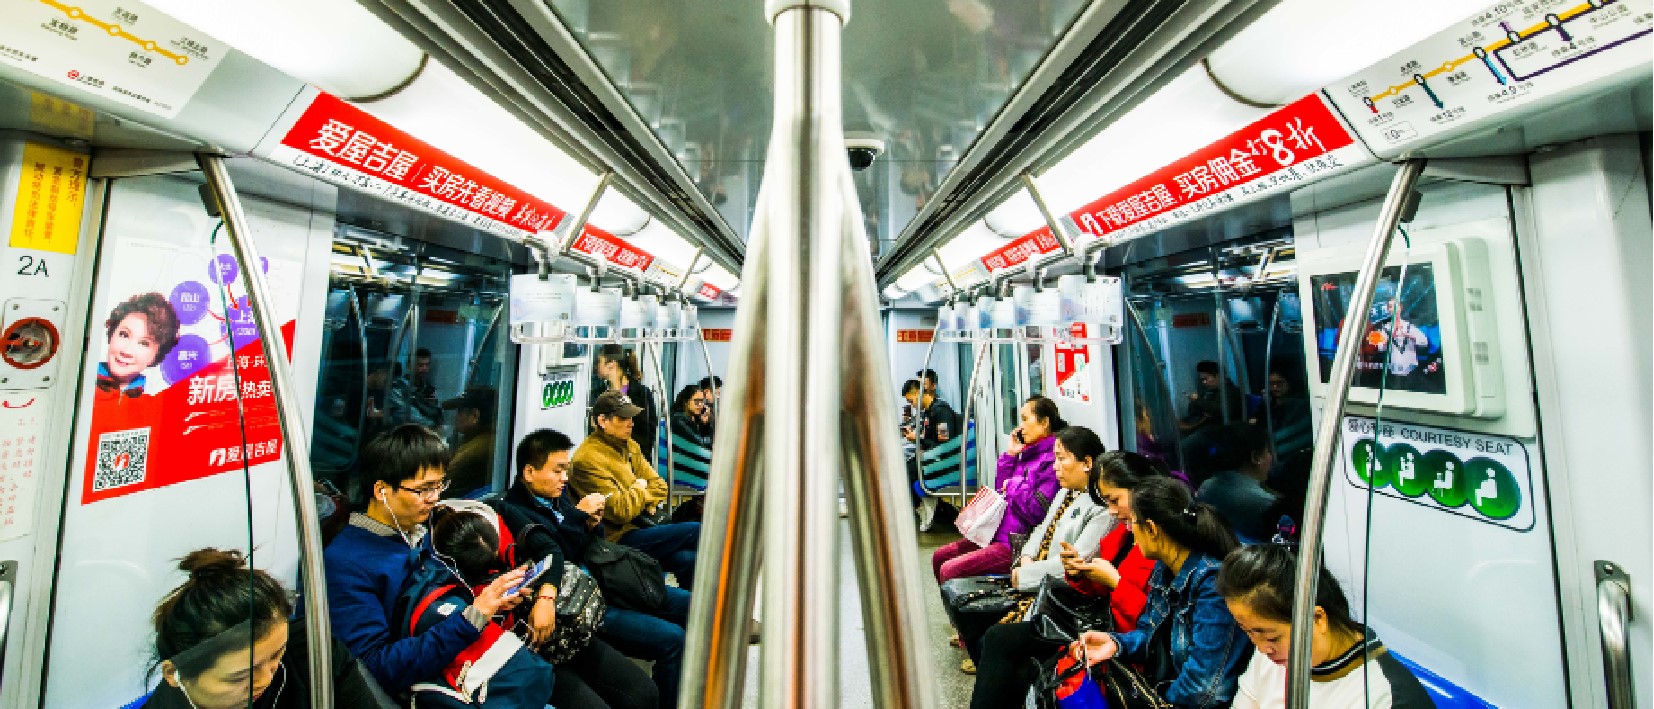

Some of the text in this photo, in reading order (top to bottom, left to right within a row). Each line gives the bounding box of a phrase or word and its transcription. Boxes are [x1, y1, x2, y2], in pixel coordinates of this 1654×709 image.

[309, 119, 419, 181] 爱屋吉屋
[419, 165, 518, 220] 买房先看视频
[17, 255, 49, 277] 2A
[1400, 427, 1514, 456] COURTESY SEAT
